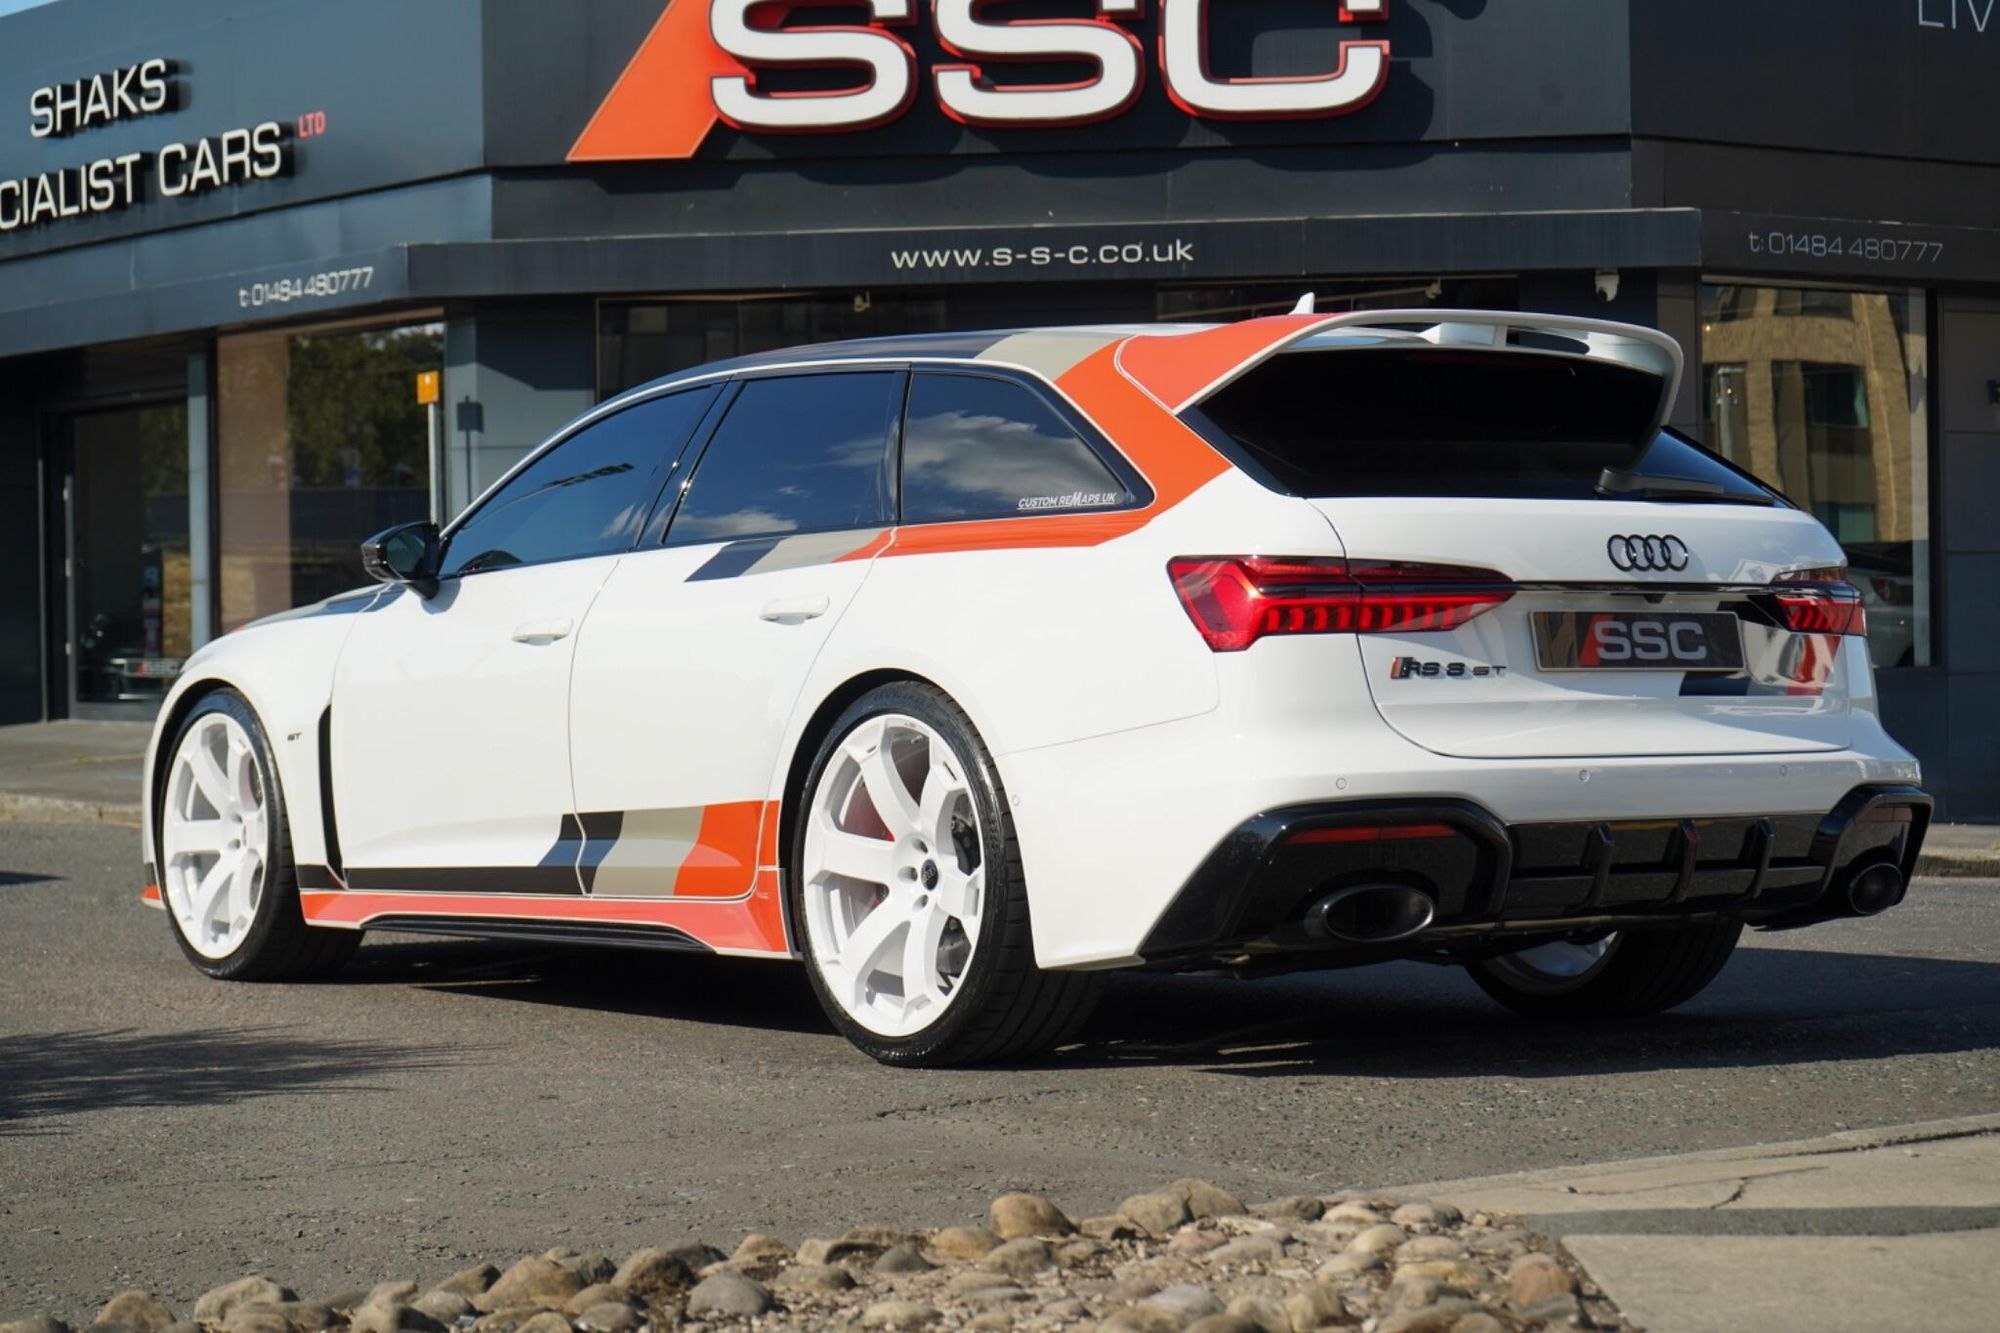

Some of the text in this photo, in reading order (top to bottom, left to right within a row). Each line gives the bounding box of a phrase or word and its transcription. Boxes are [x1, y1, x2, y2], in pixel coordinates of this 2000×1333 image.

[707, 0, 1387, 126] SSC
[30, 58, 167, 138] SHAKS
[158, 120, 281, 197] CARS
[298, 111, 326, 139] LTD
[891, 238, 1195, 269] www.s-s-c.co.uk
[1848, 238, 1944, 263] 480777
[1017, 496, 1058, 508] CUSTOM
[1101, 492, 1117, 504] UK
[1594, 620, 1707, 660] SSC
